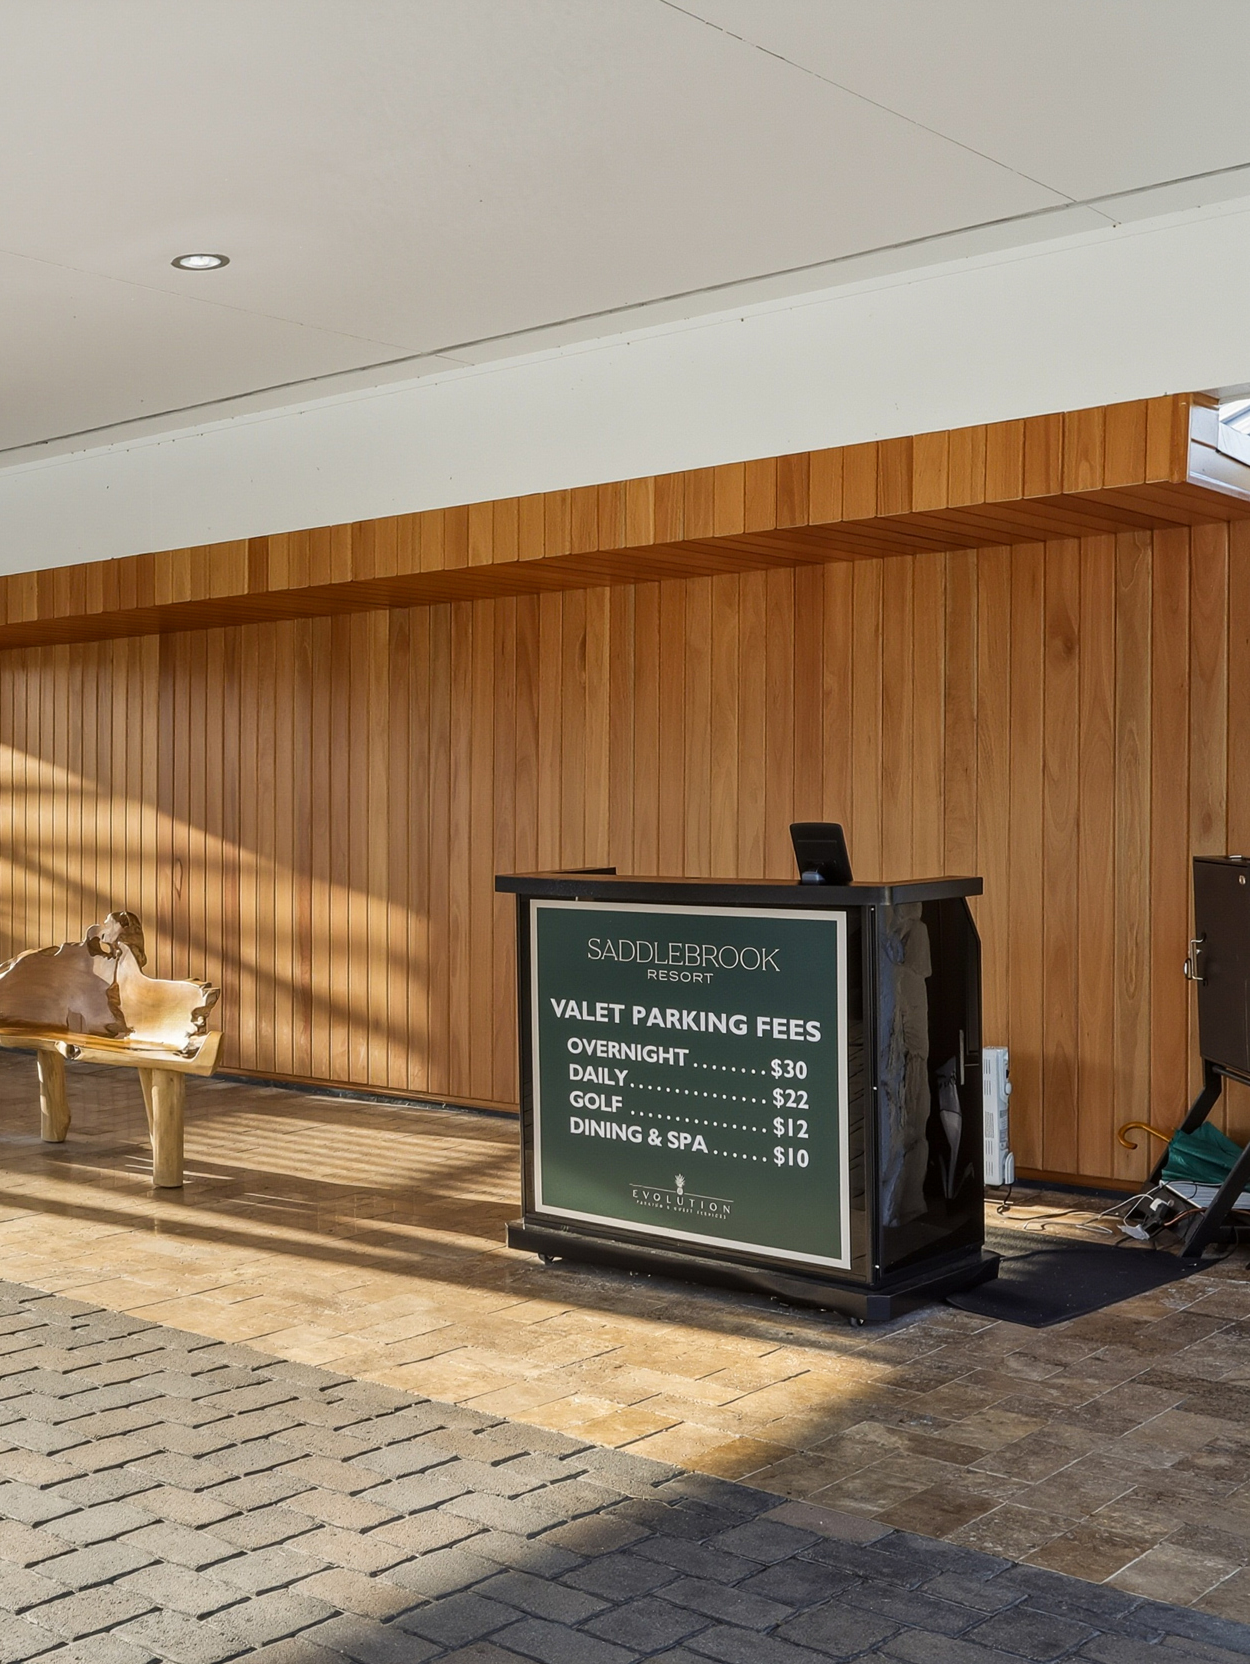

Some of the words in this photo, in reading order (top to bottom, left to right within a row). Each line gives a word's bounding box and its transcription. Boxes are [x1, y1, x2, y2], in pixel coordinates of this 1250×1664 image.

[587, 938, 781, 972] SADDLEBROOK
[647, 969, 714, 984] RESORT
[550, 998, 625, 1024] VALET
[632, 1005, 748, 1036] PARKING
[756, 1016, 822, 1043] FEES
[567, 1037, 690, 1067] OVERNIGHT
[771, 1058, 808, 1080] $30
[569, 1063, 629, 1087] DAILY
[772, 1087, 810, 1110] $22
[569, 1090, 623, 1113] GOLF
[773, 1116, 809, 1139] $12
[570, 1116, 643, 1144] DINING
[647, 1128, 663, 1147] &
[667, 1131, 709, 1154] SPA
[773, 1145, 810, 1168] $10
[632, 1189, 731, 1214] EVOLUTION
